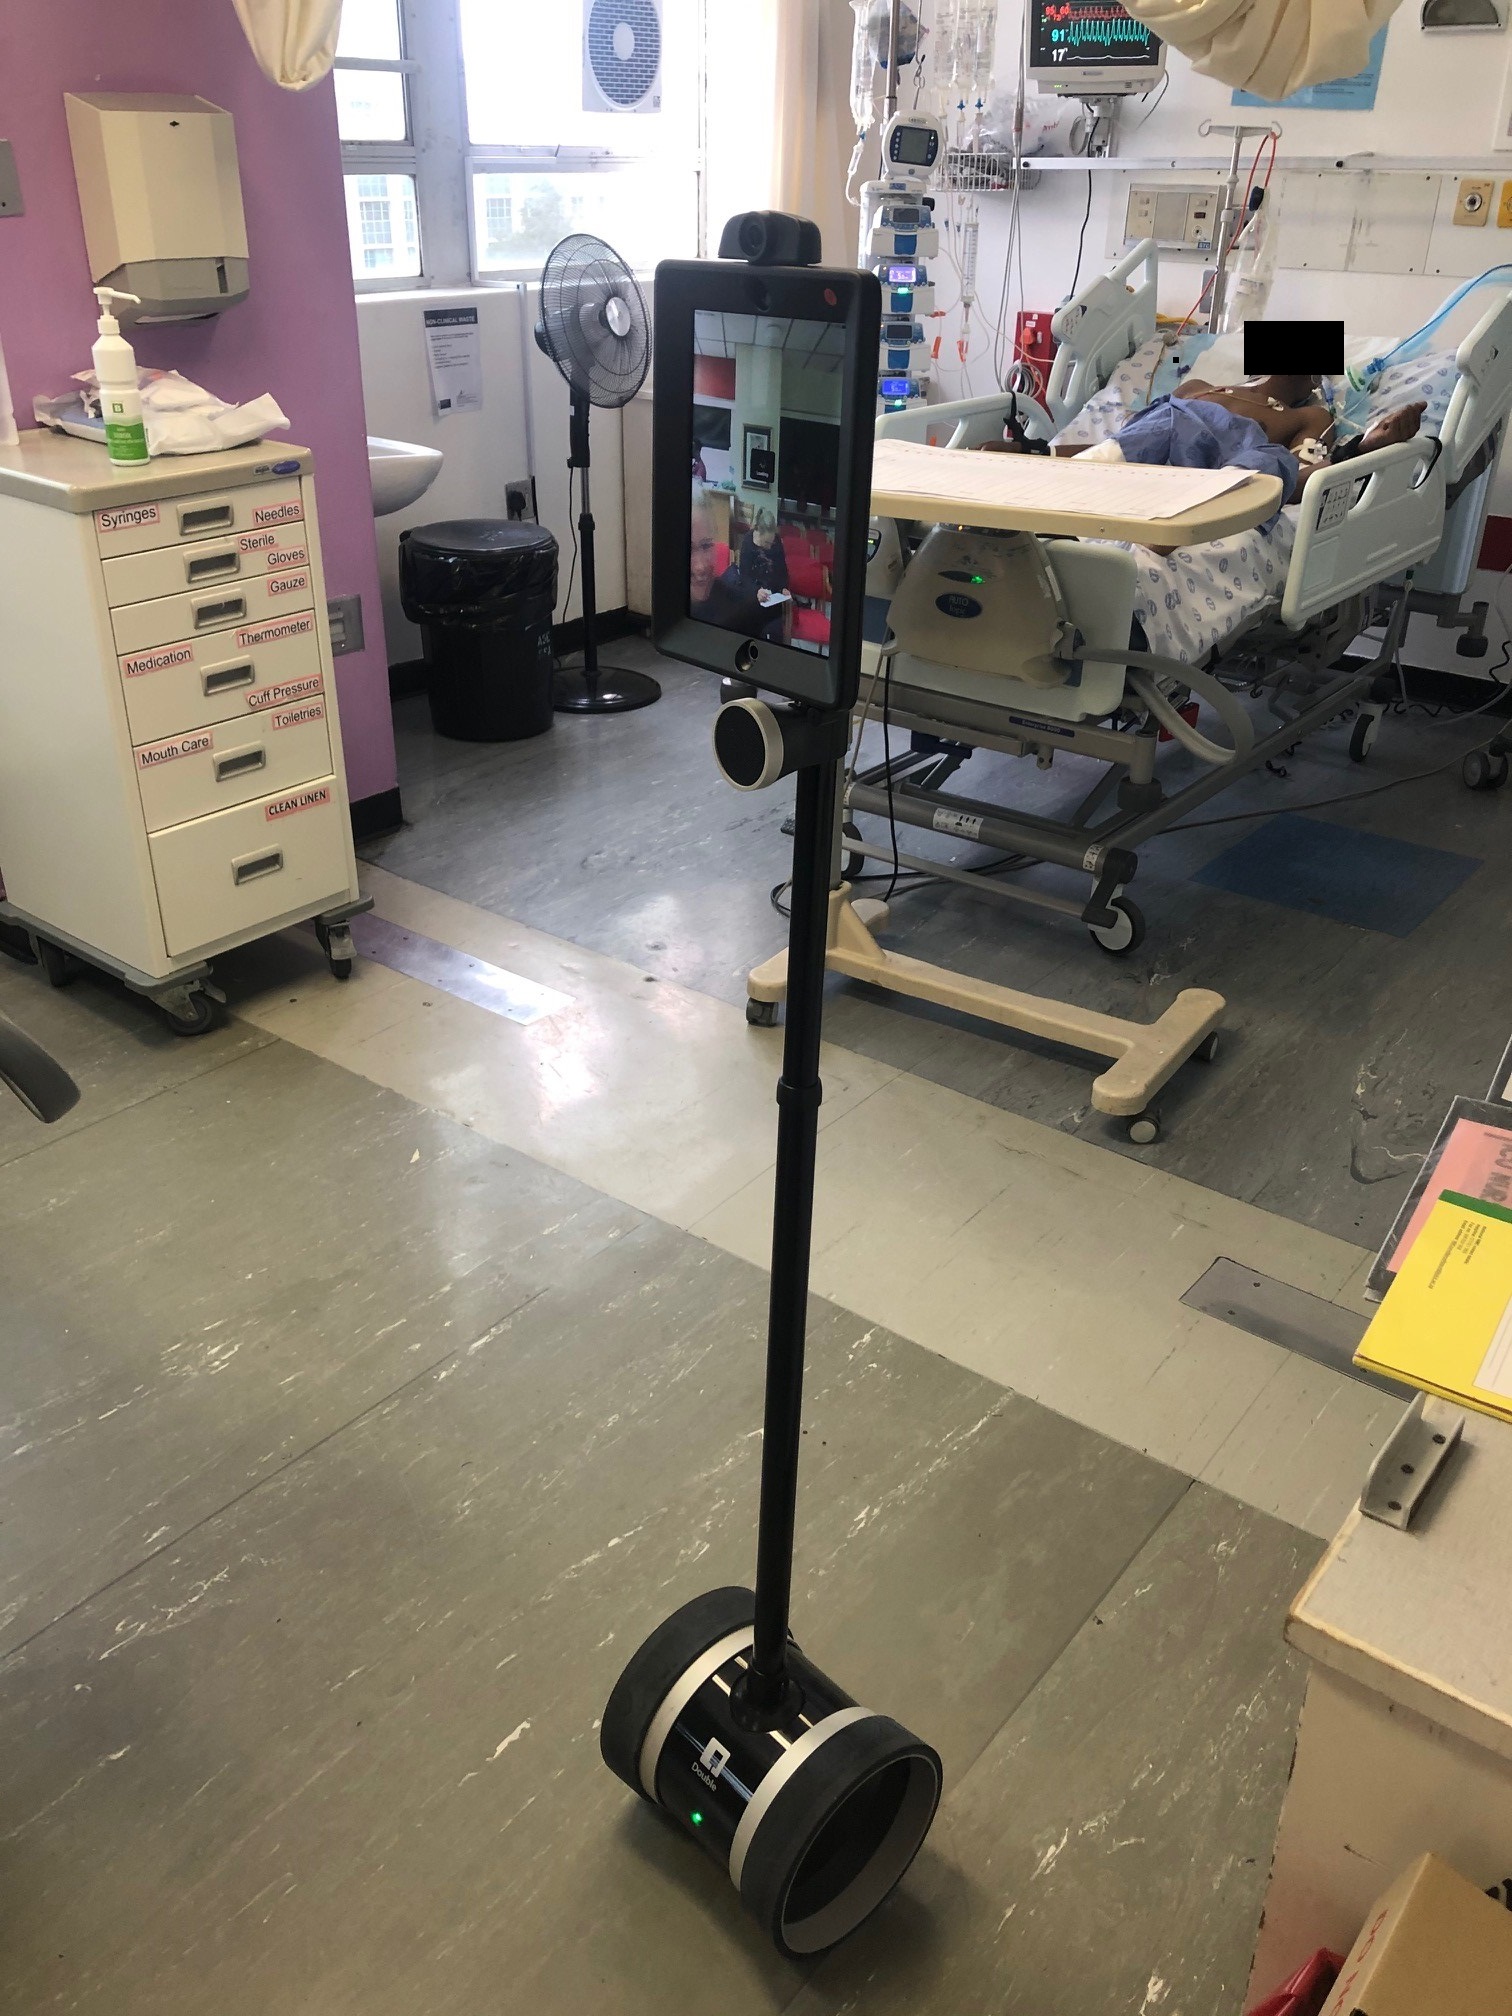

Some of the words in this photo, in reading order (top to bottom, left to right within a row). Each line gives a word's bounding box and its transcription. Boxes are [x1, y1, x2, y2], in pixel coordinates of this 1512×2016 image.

[1051, 29, 1065, 42] 91
[1052, 49, 1065, 62] 17
[101, 506, 156, 528] Syringes
[255, 504, 300, 523] Needles
[240, 534, 275, 551] Sterile
[268, 549, 305, 566] Gloves
[270, 576, 305, 593] Gauze
[239, 619, 310, 646] Thermometer
[126, 649, 191, 675] Medication
[248, 691, 271, 708] Cuff
[274, 678, 319, 700] Pressure
[275, 705, 322, 727] Toiletries
[141, 746, 178, 765] Mouth
[181, 737, 209, 752] Care
[269, 798, 298, 816] CLEAN
[300, 790, 326, 806] LINEN
[691, 1761, 717, 1792] Double
